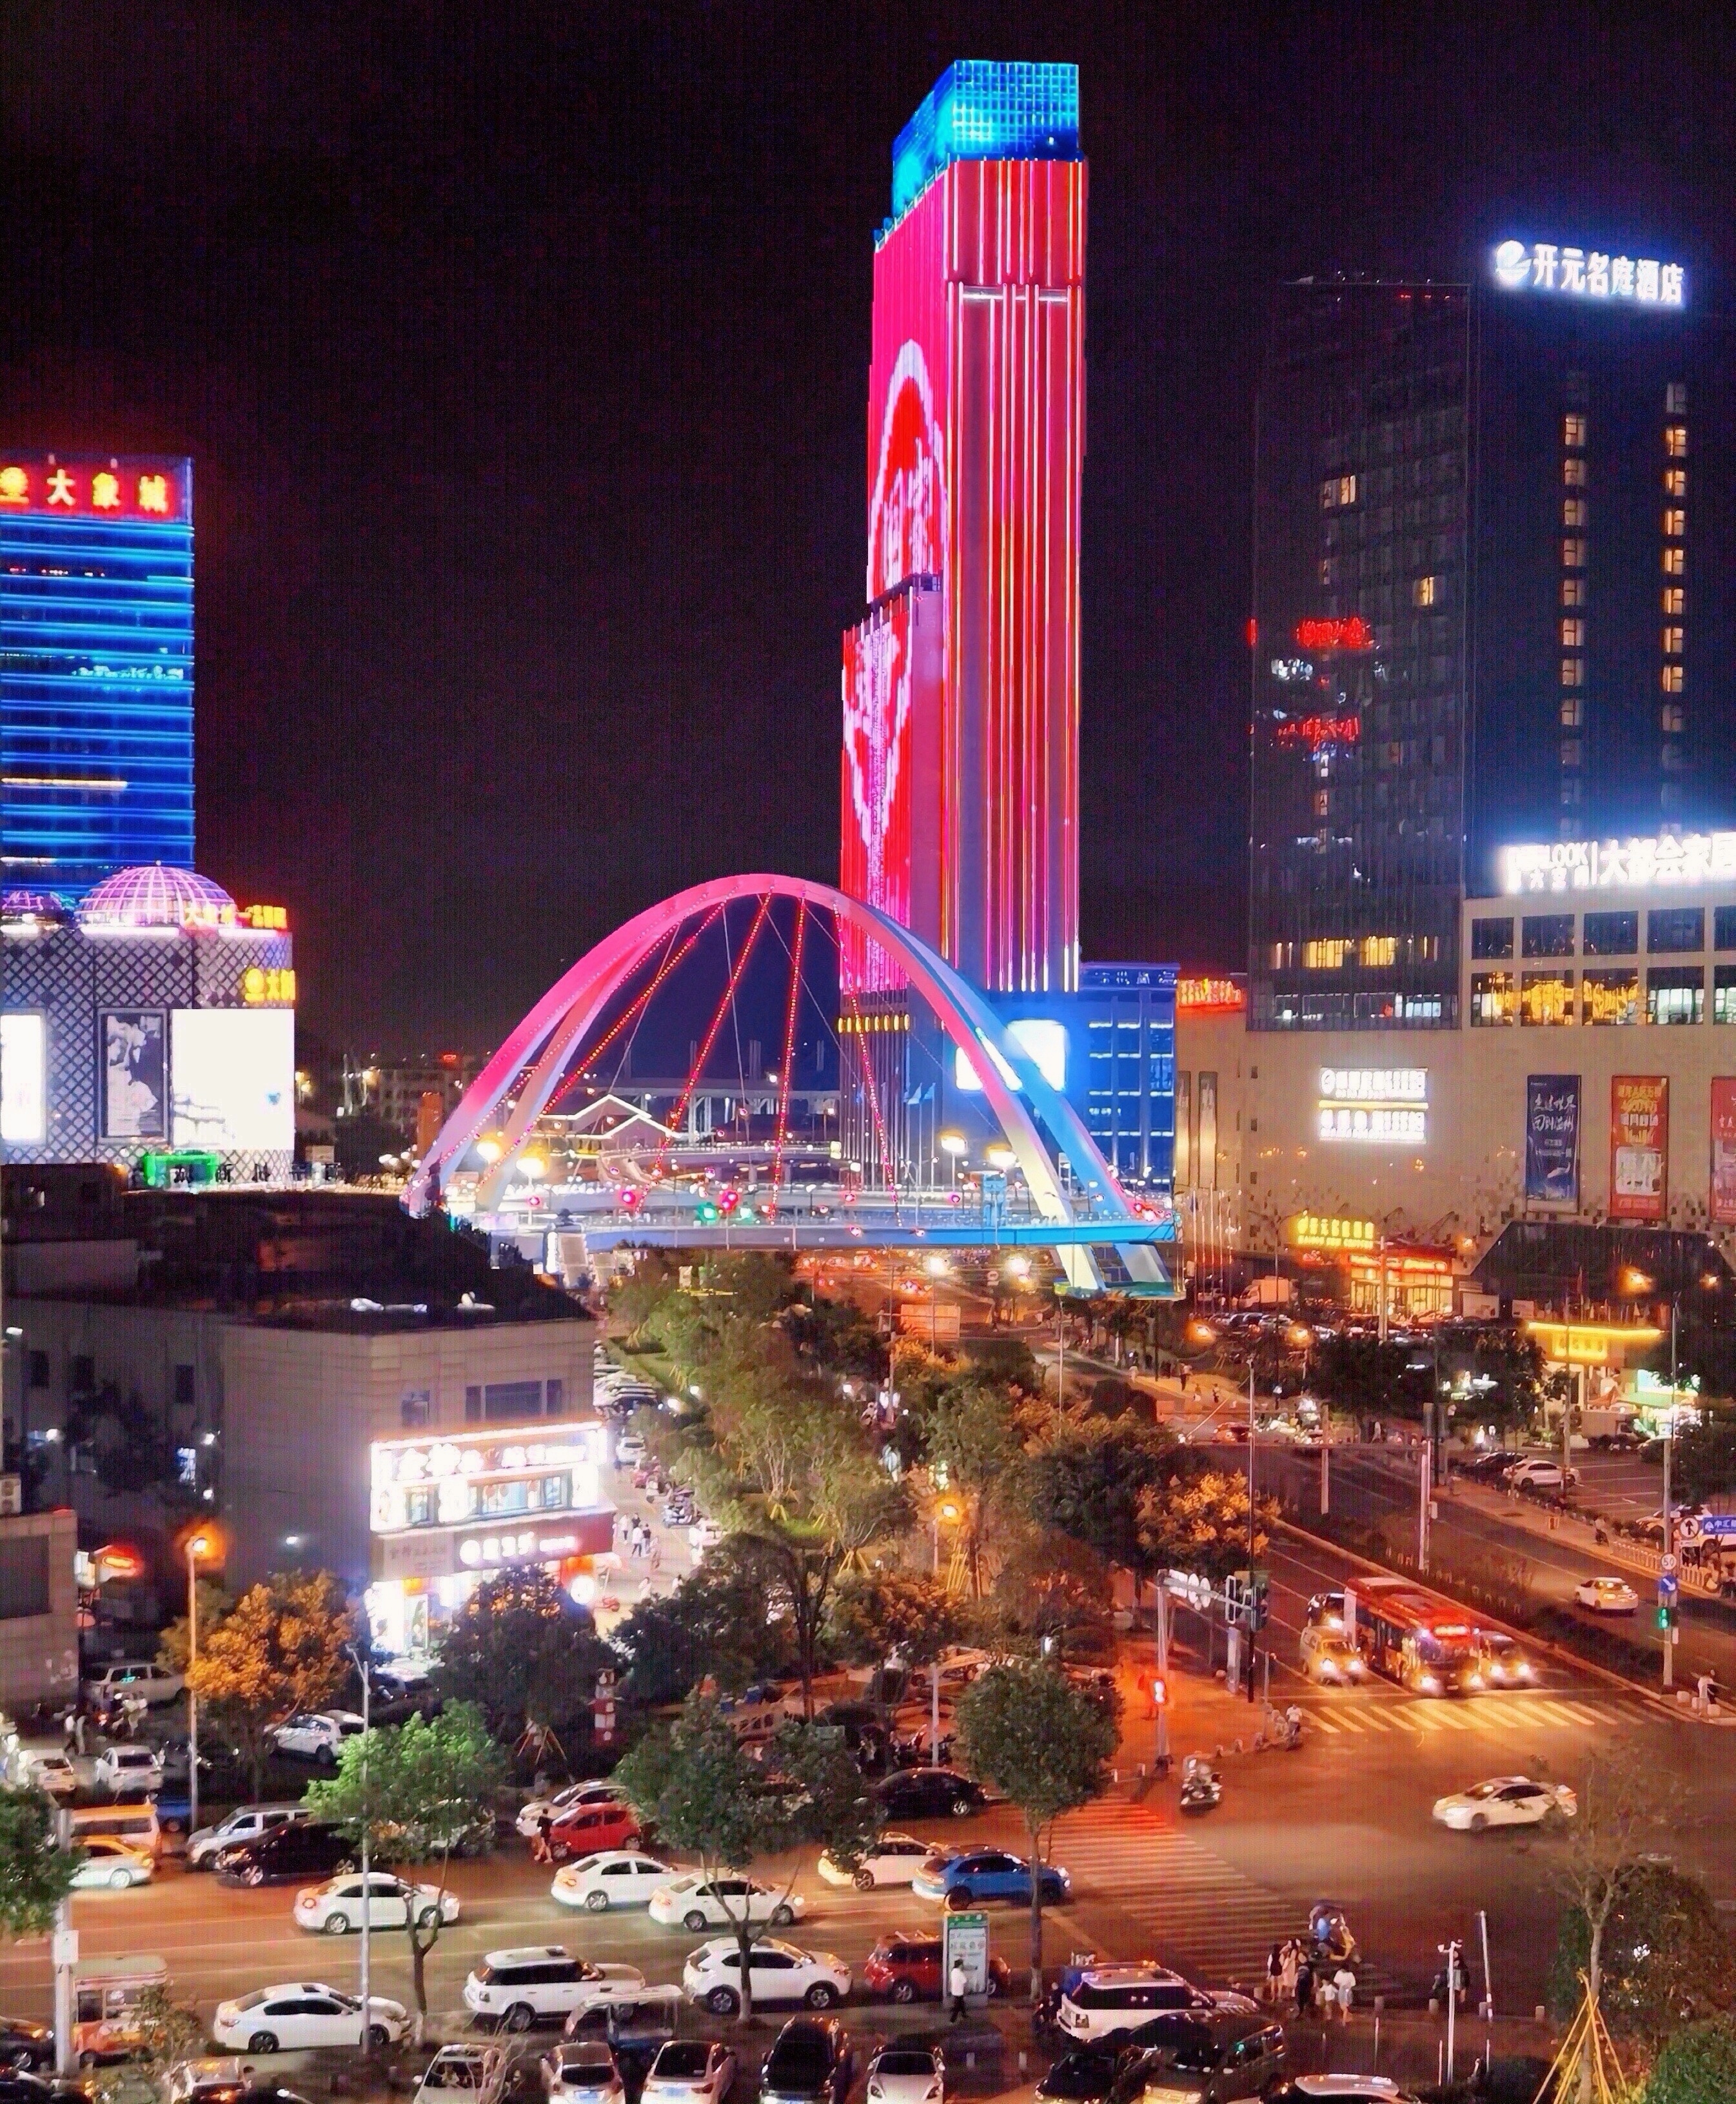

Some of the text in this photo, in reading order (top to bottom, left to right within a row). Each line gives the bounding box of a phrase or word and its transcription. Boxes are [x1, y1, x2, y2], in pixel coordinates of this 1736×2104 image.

[1533, 243, 1684, 304] 开元名庭酒店
[1664, 1556, 1675, 1567] 50
